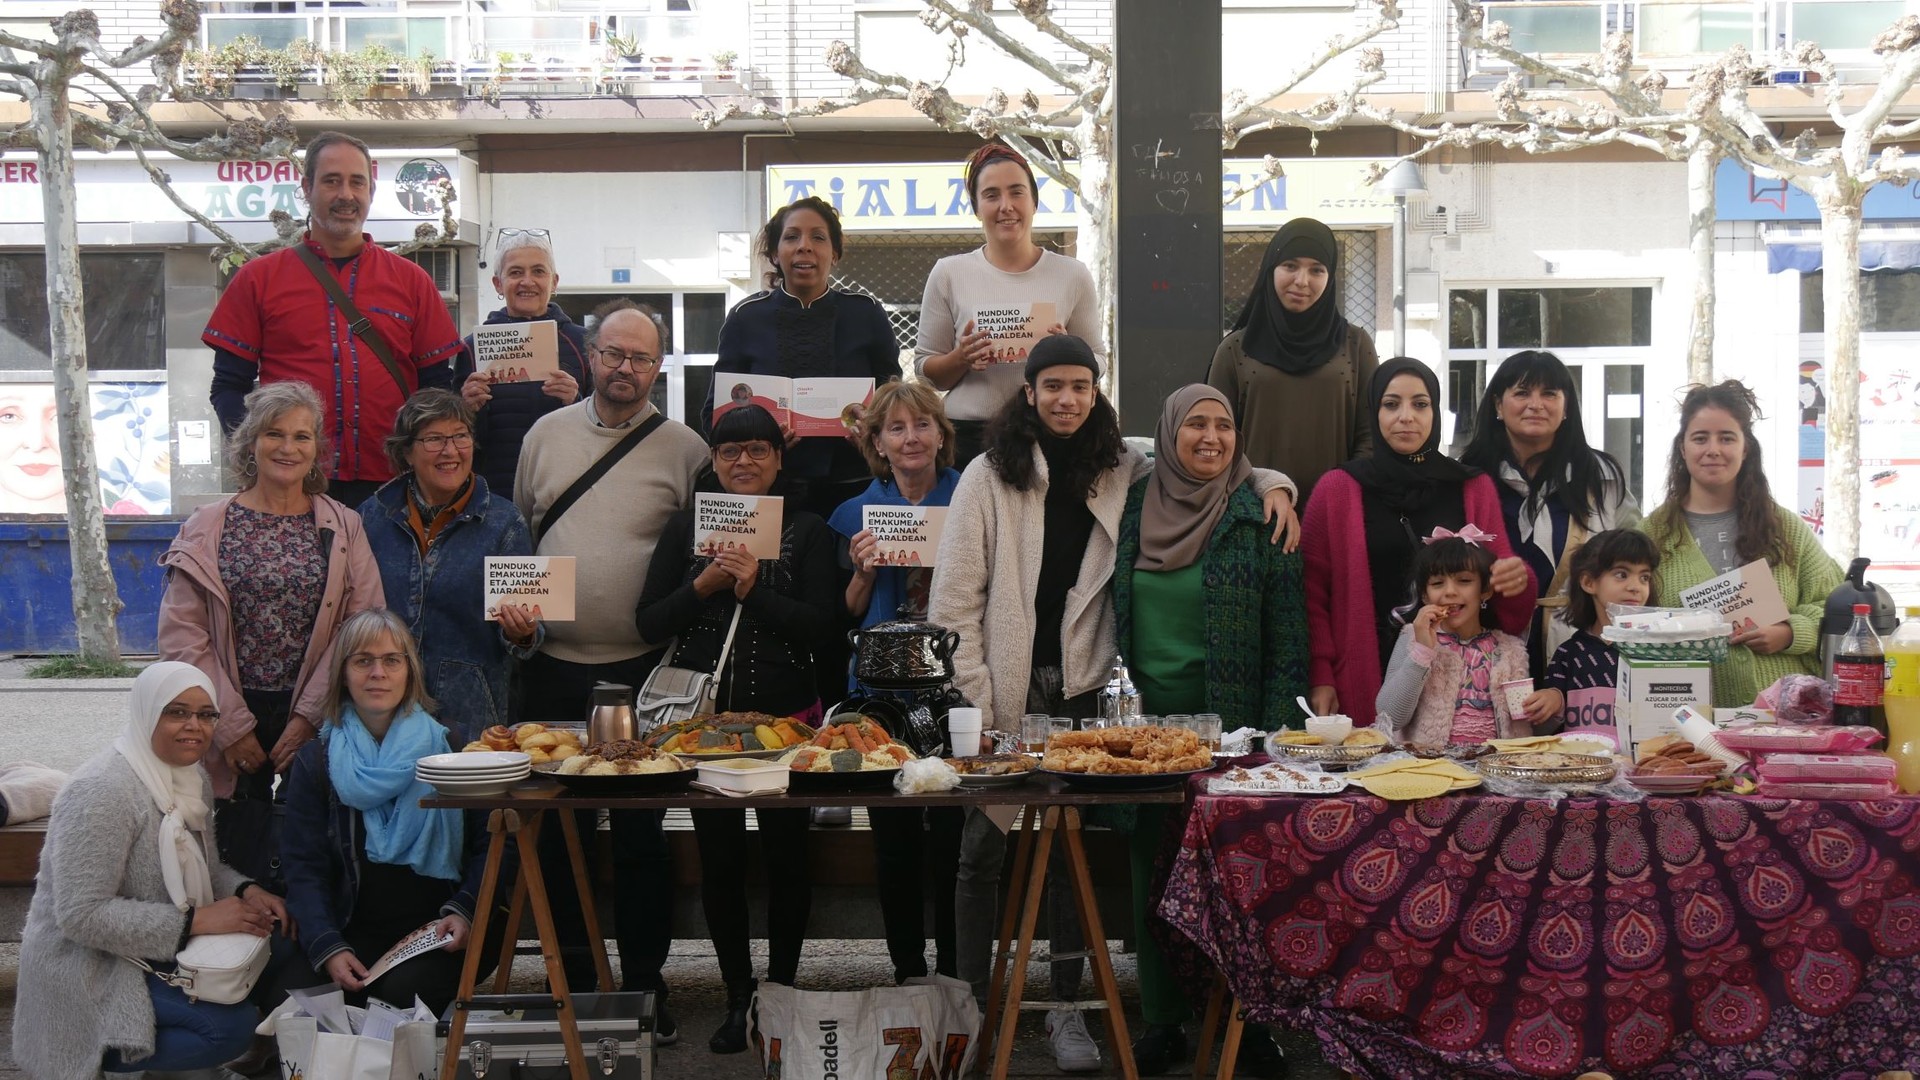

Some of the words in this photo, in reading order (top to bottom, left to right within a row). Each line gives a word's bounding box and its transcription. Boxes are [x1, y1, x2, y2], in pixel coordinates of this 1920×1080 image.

[0, 162, 39, 184] ER
[976, 309, 1020, 317] MUNDUKO
[997, 324, 1025, 332] JANAK
[477, 330, 519, 339] MUNDUKO
[496, 345, 524, 353] JANAK
[479, 352, 533, 361] AIARALDEAN
[700, 499, 745, 509] MUNDUKO
[868, 511, 914, 519] MUNDUKO
[699, 515, 717, 523] ETA
[719, 517, 748, 526] JANAK
[699, 523, 756, 535] AIARALDEAN
[868, 526, 886, 534] ETA
[489, 587, 549, 595] AIARALDEAN
[1685, 579, 1731, 603] MUNDUKO
